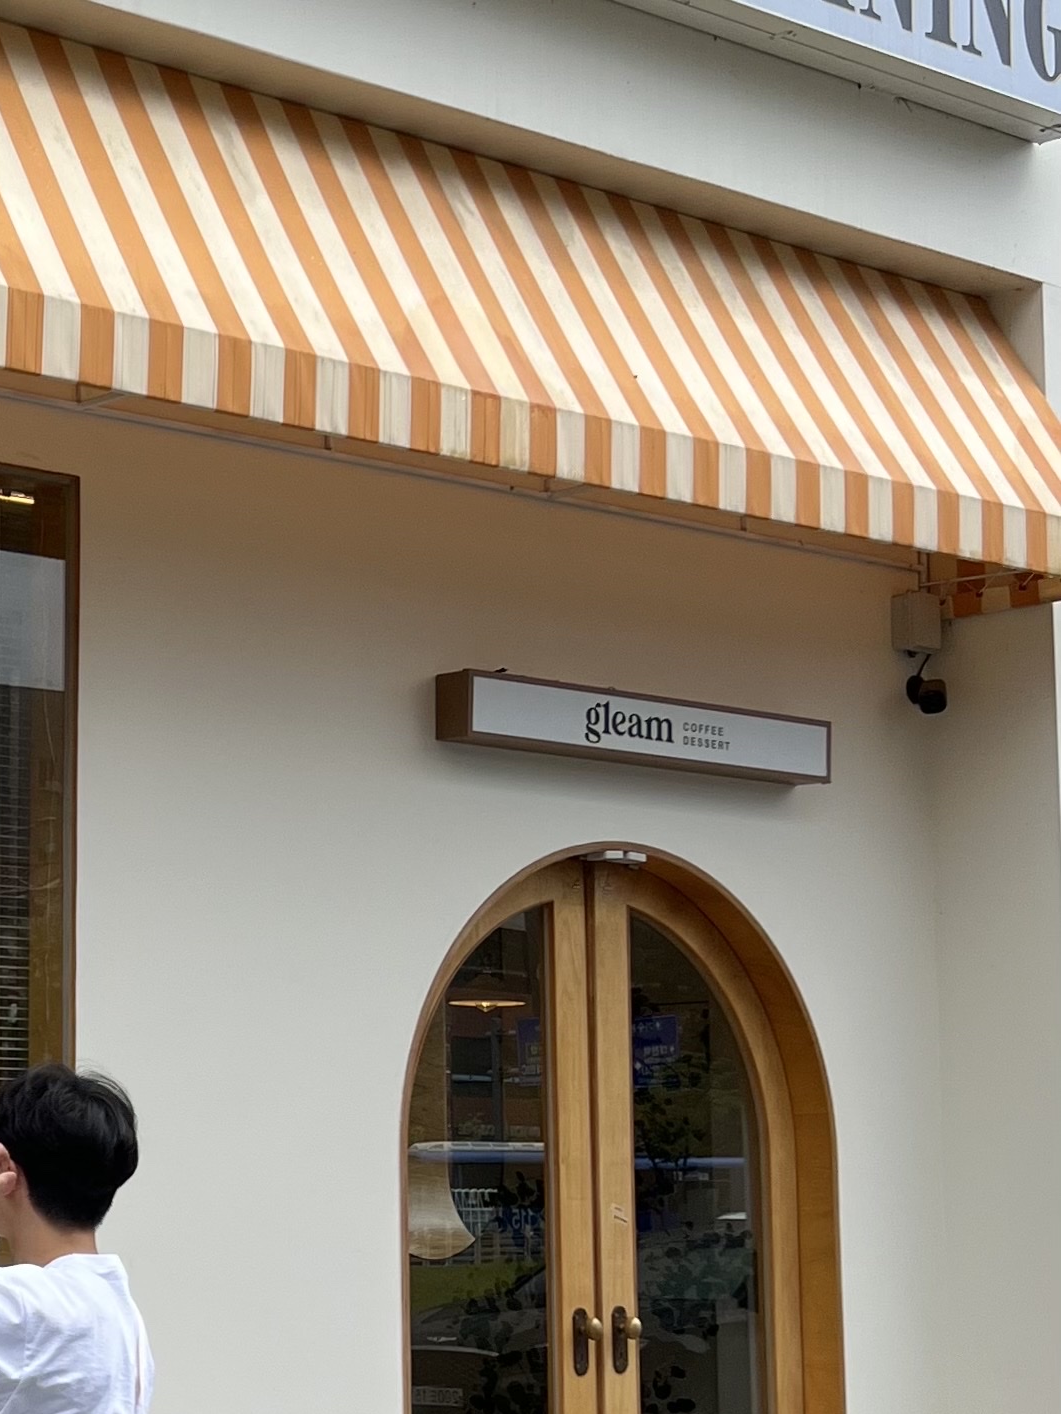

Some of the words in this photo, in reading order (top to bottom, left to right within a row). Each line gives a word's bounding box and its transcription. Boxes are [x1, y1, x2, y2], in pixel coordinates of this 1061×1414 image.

[584, 700, 675, 744] gleam
[682, 722, 724, 737] COFFEE
[682, 736, 731, 751] DESSERT
